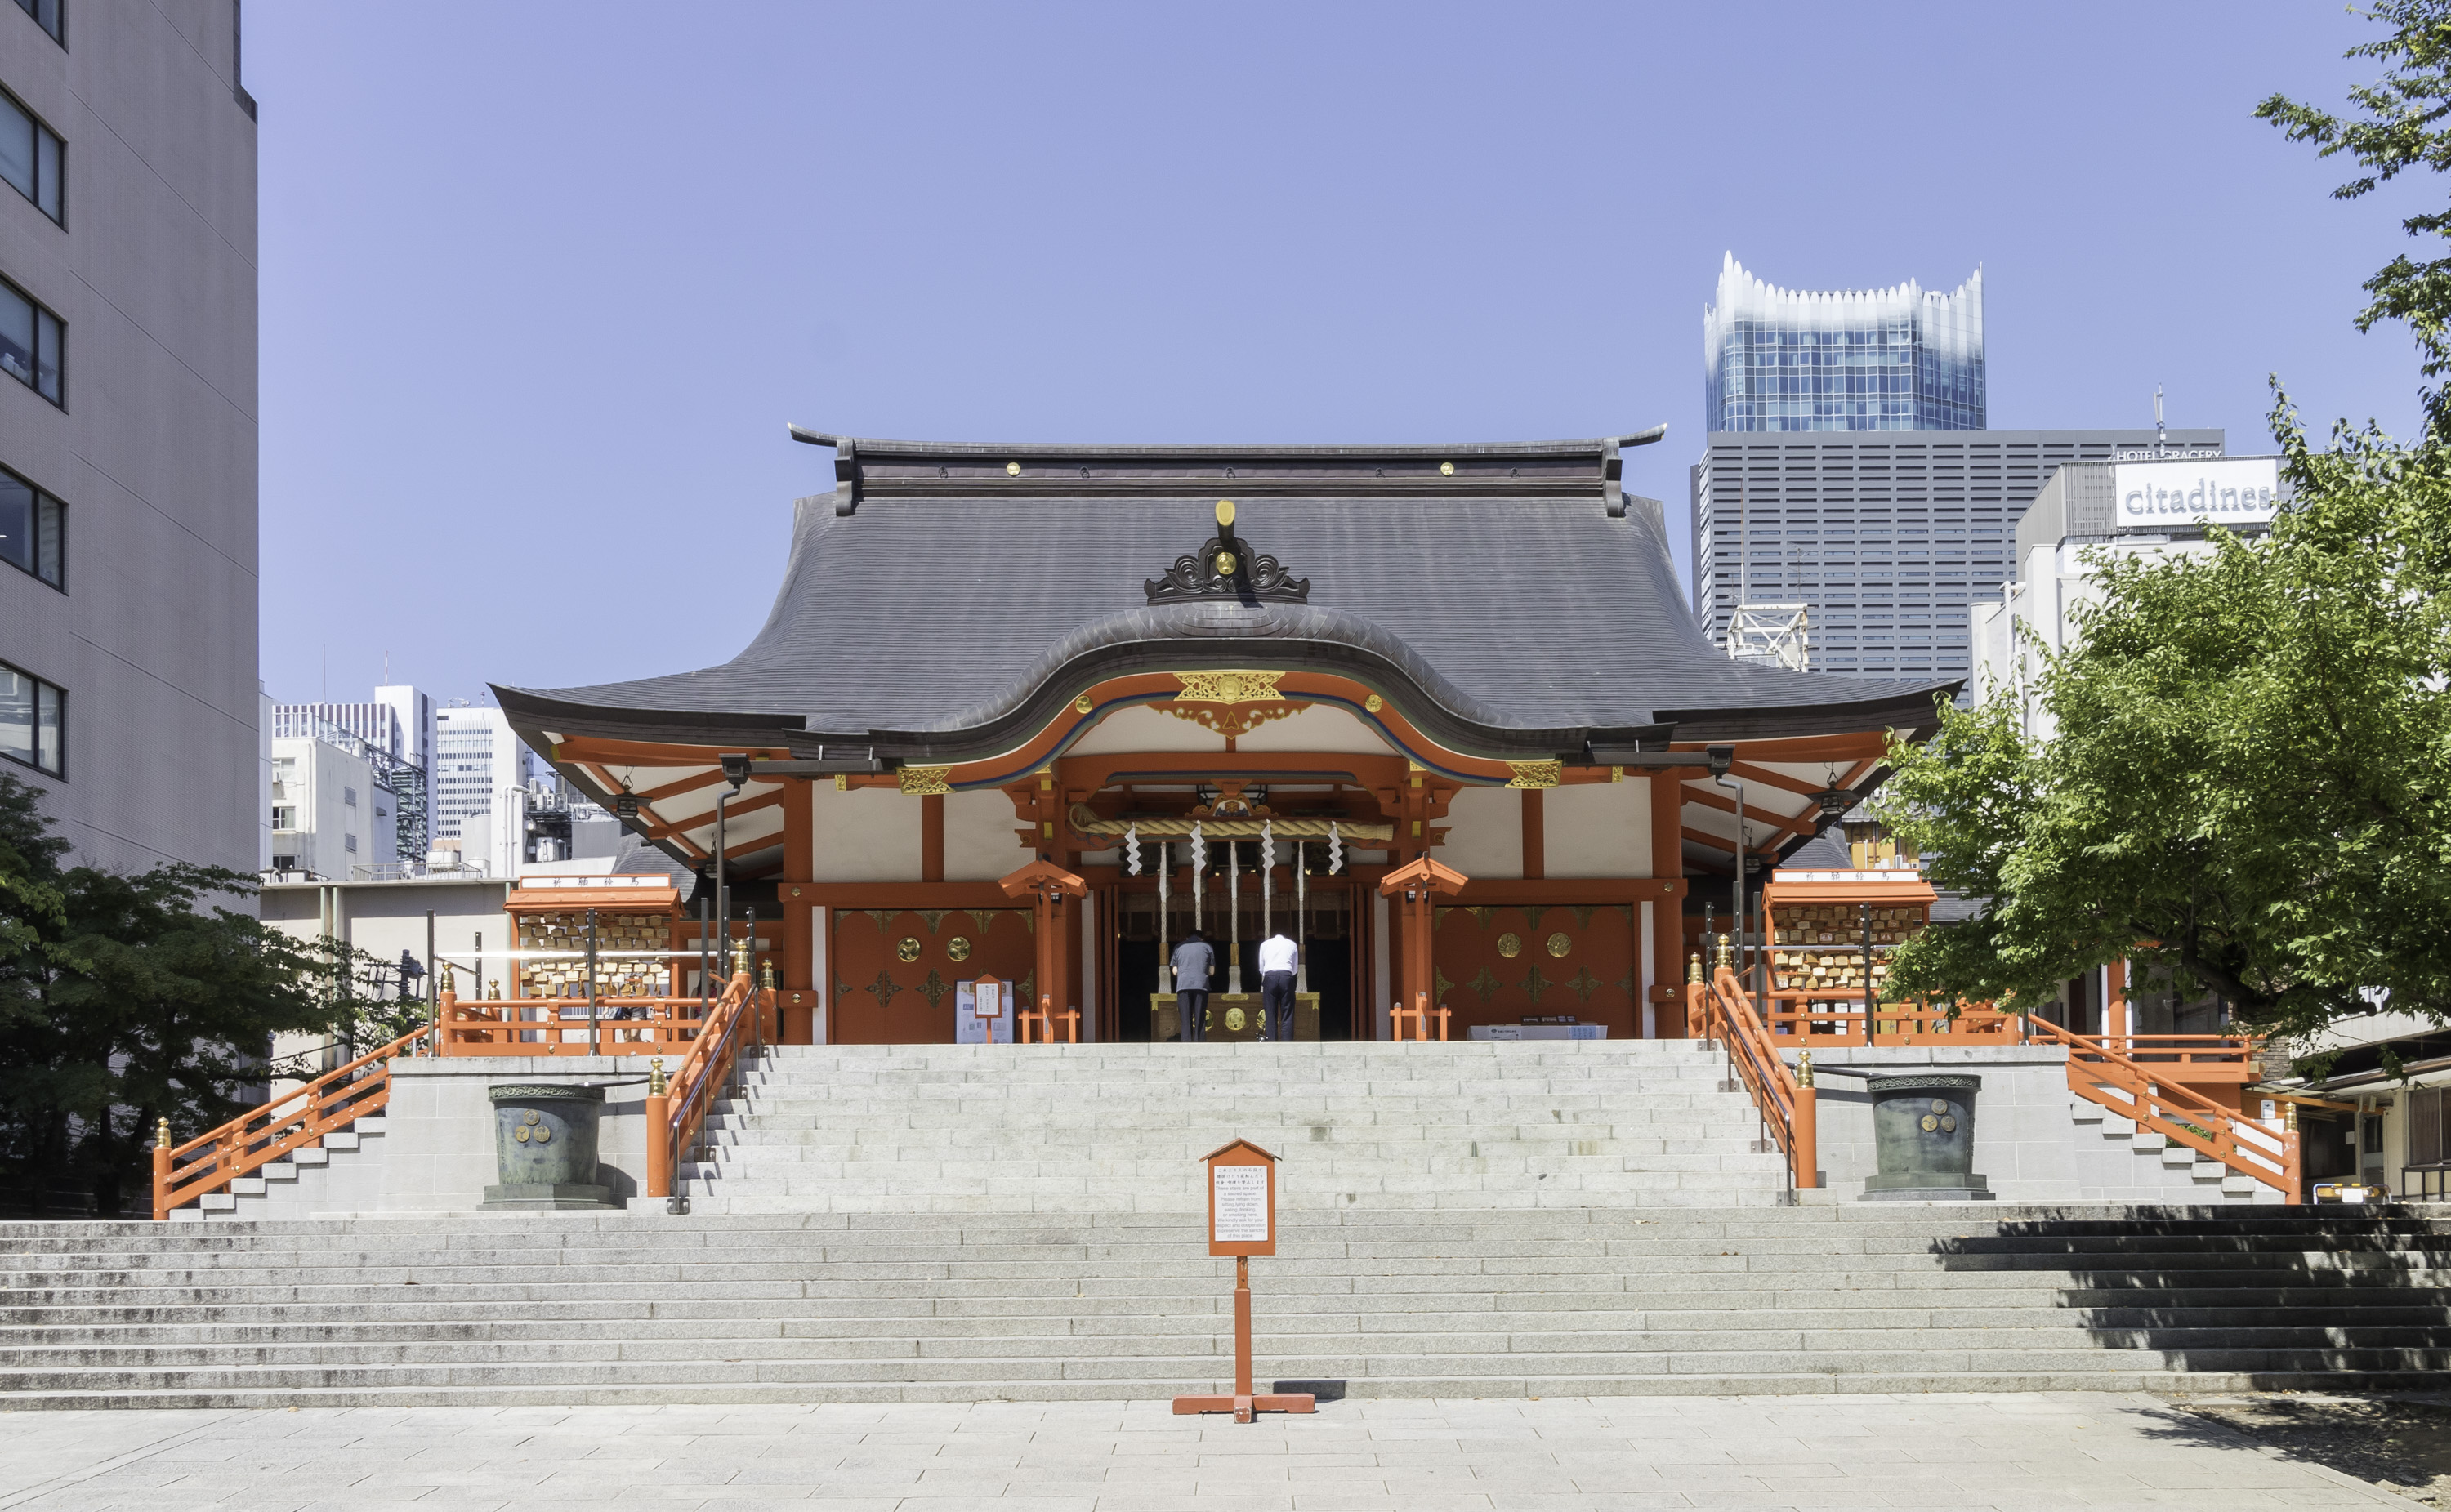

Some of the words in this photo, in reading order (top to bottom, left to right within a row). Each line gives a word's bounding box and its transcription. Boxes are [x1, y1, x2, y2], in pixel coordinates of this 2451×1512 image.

[2163, 450, 2222, 459] GRACERY
[2126, 477, 2270, 515] citadines
[552, 876, 639, 887] 祈願絵馬
[1806, 872, 1890, 881] 祈願絵馬
